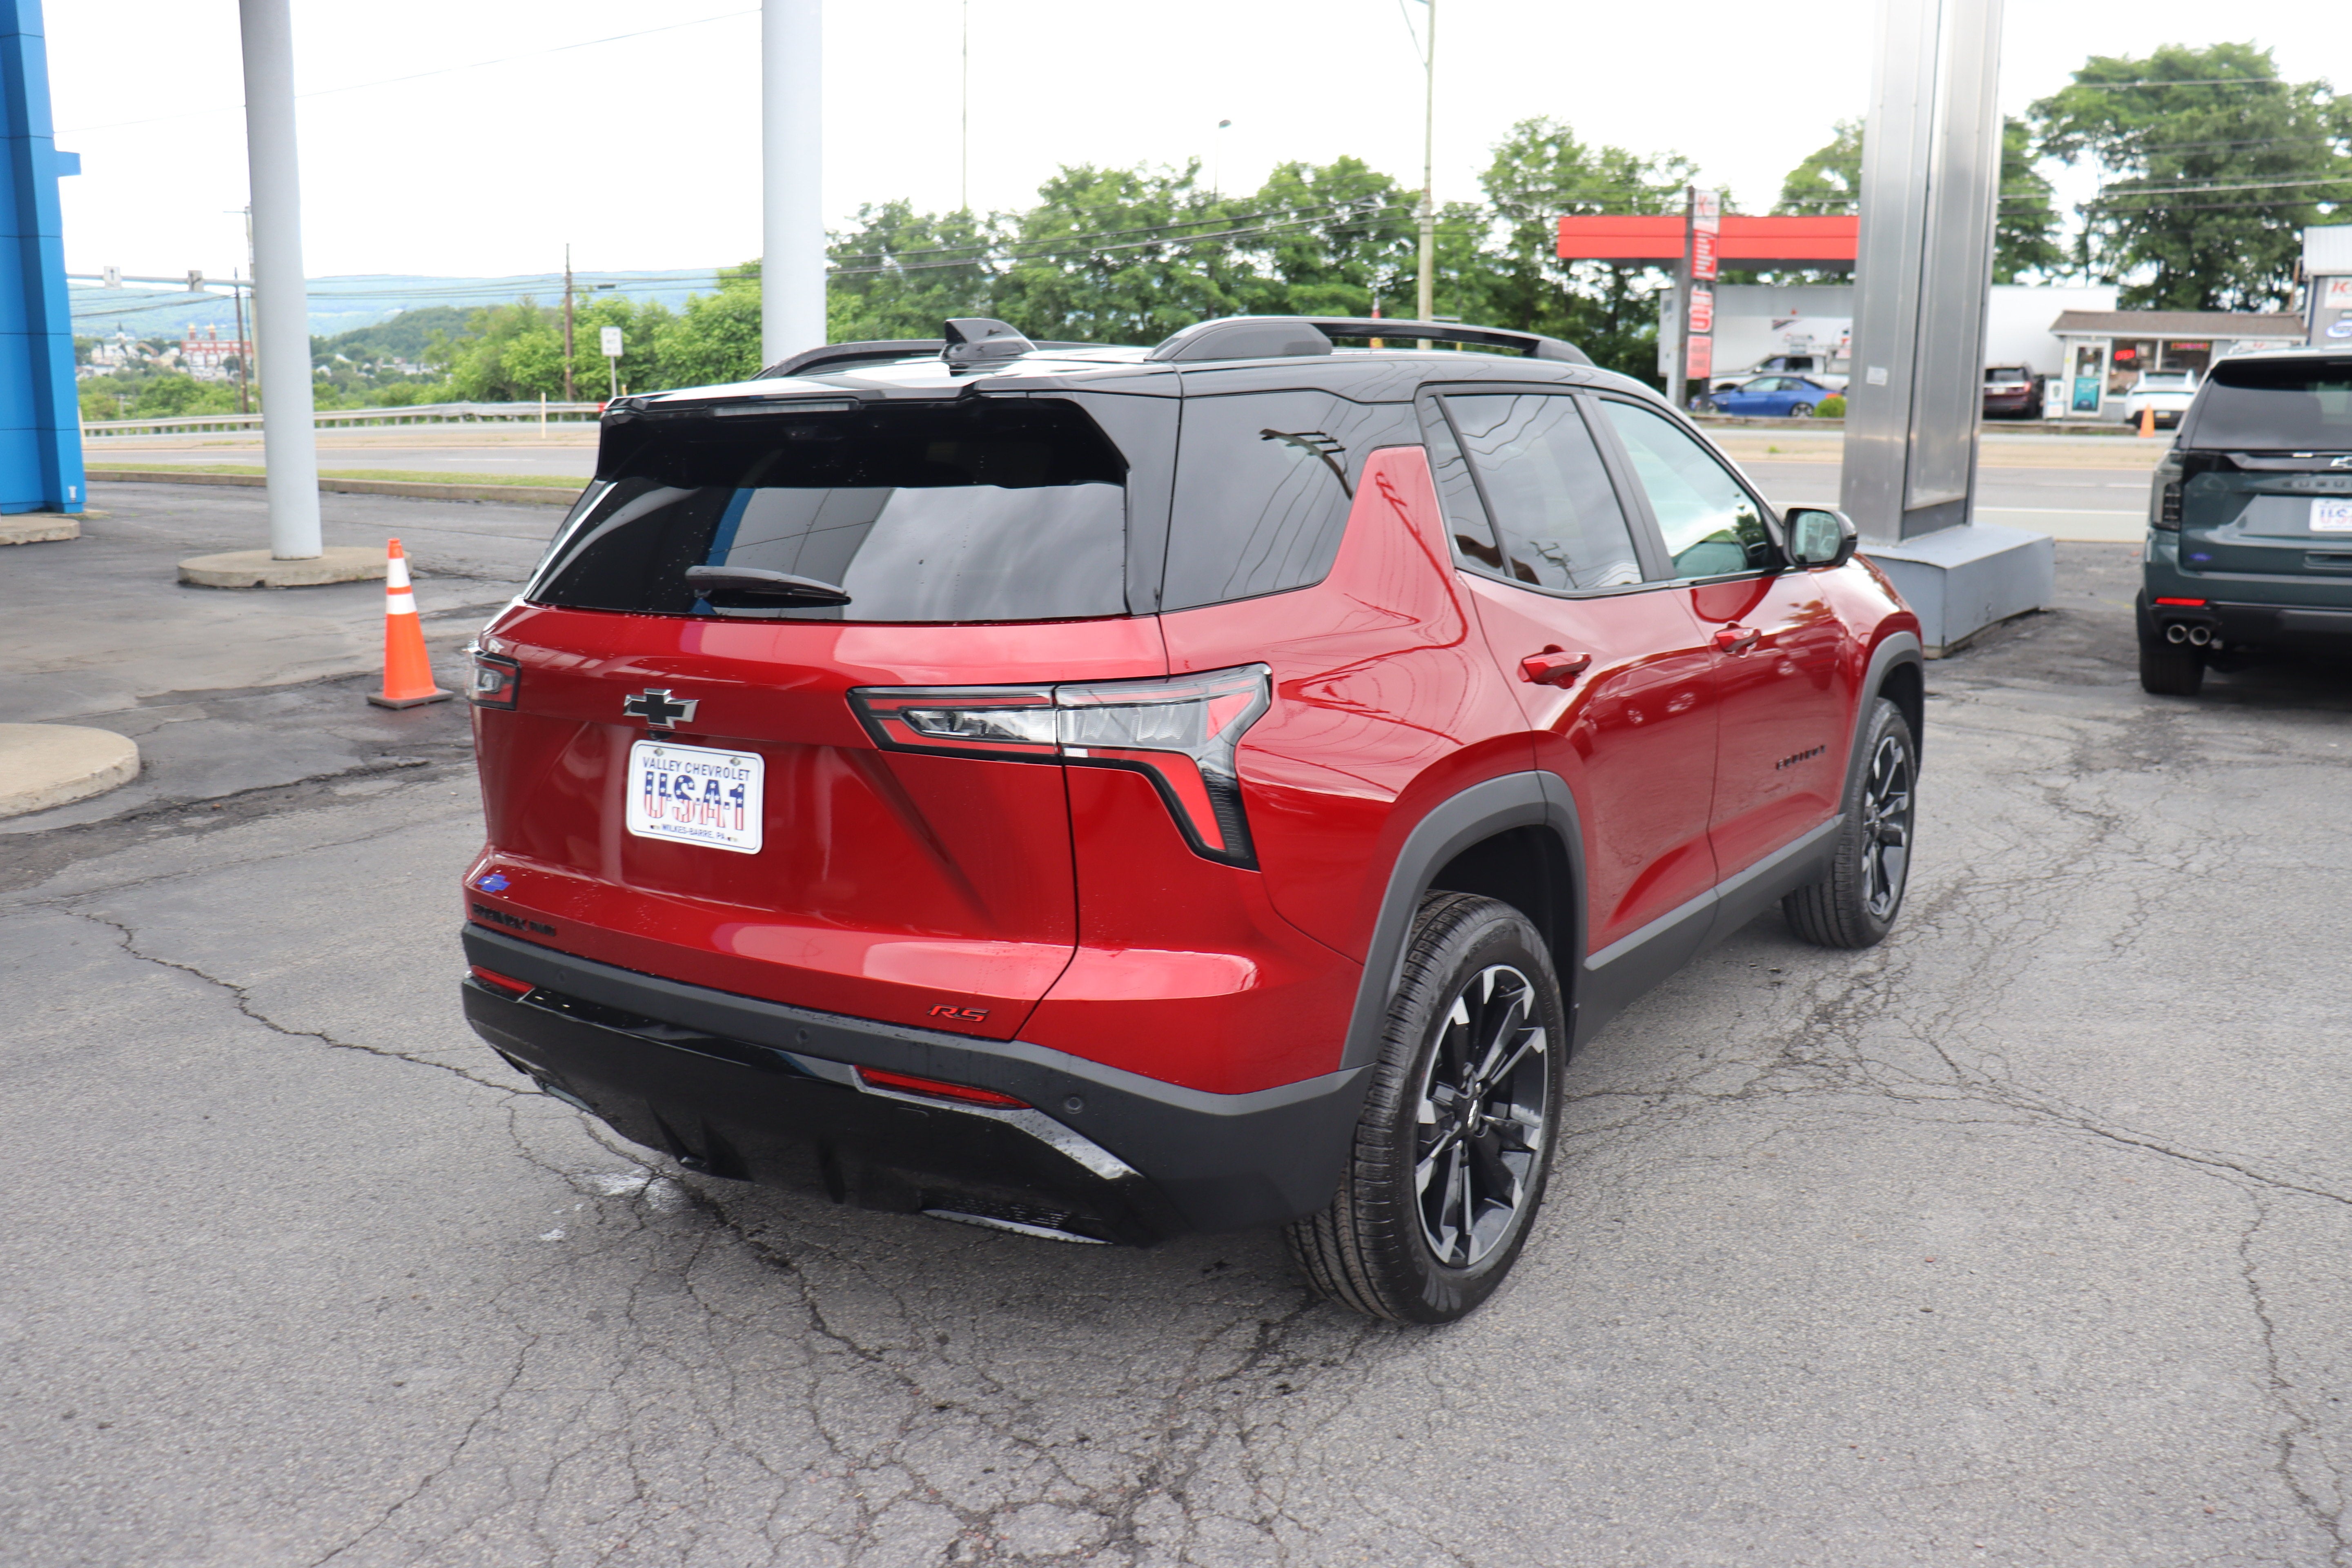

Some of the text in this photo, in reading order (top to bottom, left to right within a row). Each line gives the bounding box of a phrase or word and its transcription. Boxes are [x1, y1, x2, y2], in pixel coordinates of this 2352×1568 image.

[642, 757, 751, 782] VALLEY CHEVROLET
[927, 1004, 990, 1022] RS
